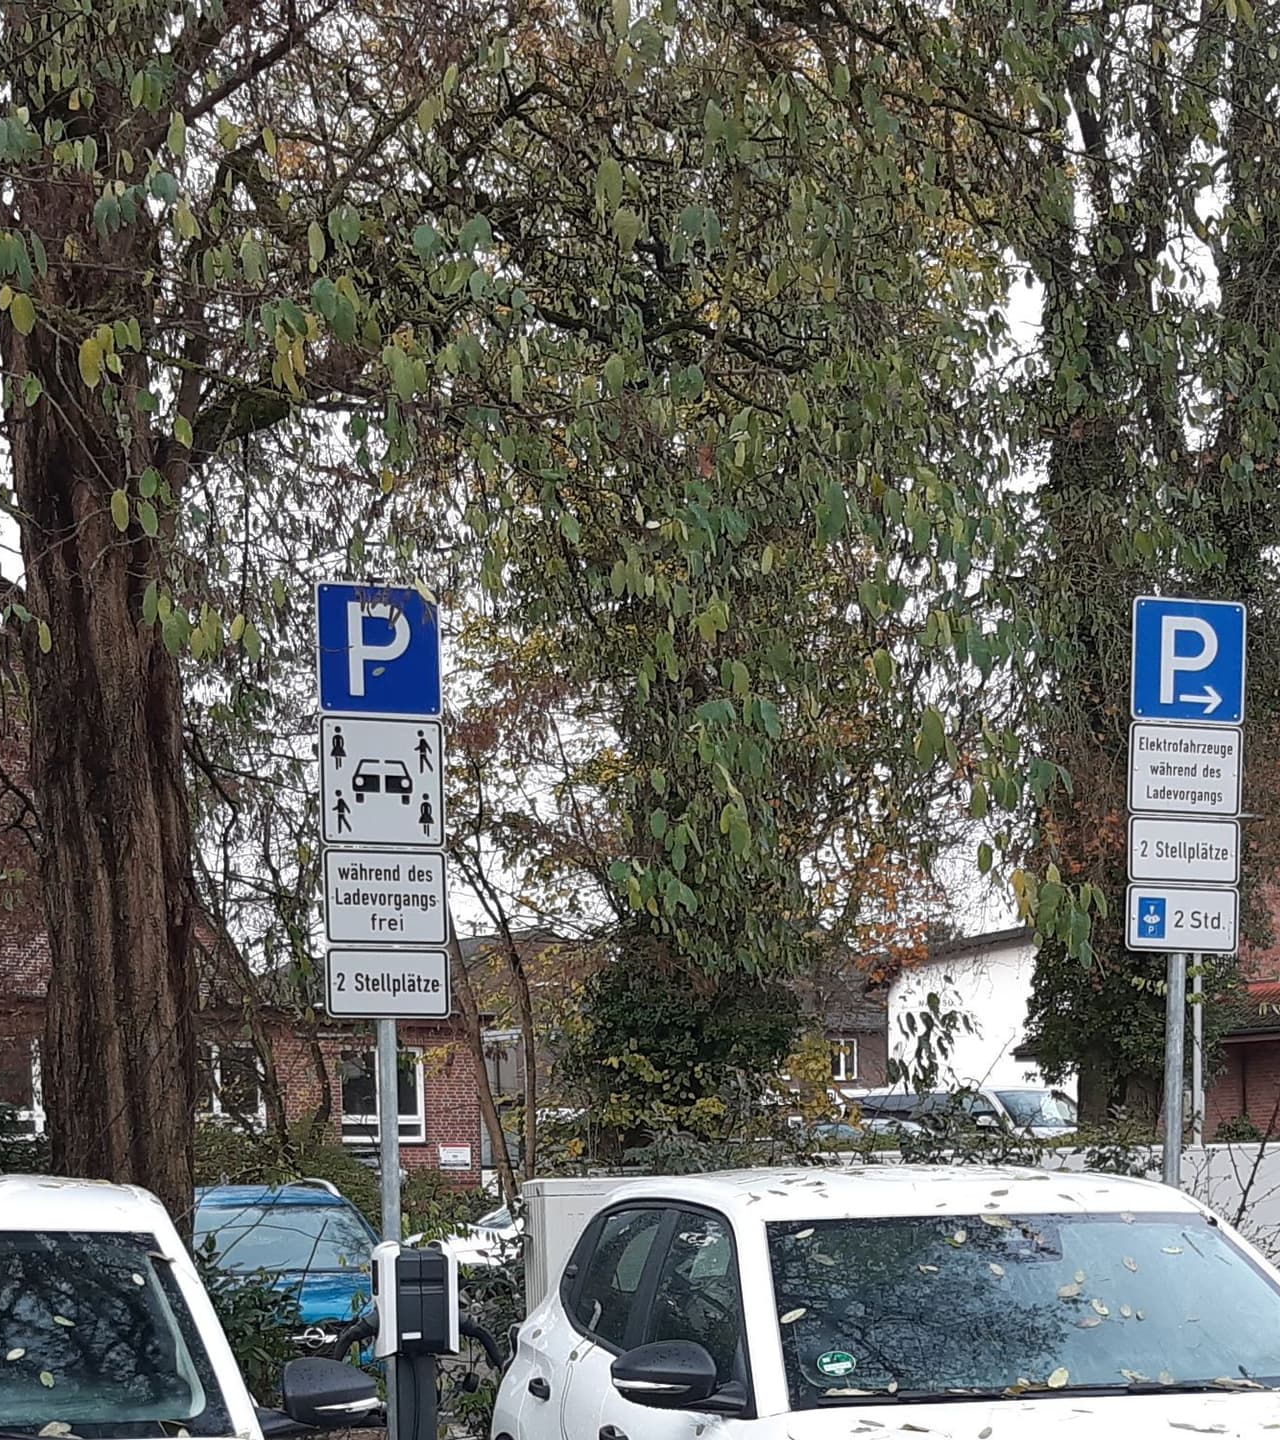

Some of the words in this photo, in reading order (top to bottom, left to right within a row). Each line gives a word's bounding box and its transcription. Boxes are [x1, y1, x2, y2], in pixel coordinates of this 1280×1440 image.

[347, 600, 412, 697] P
[1160, 615, 1219, 704] P
[1138, 736, 1233, 759] Elektrofahrzeuge
[1150, 761, 1197, 777] während
[1202, 763, 1222, 779] des
[1146, 785, 1223, 805] Ladevorgangs
[1140, 839, 1148, 858] 2
[1155, 840, 1229, 864] Stellplätze
[338, 863, 400, 881] während
[408, 864, 433, 882] des
[335, 887, 436, 912] Ladevorgangs
[371, 913, 404, 932] frei
[1174, 909, 1184, 929] 2
[1190, 910, 1226, 931] Std.
[336, 972, 346, 993] 2
[354, 971, 440, 998] Stellplätze
